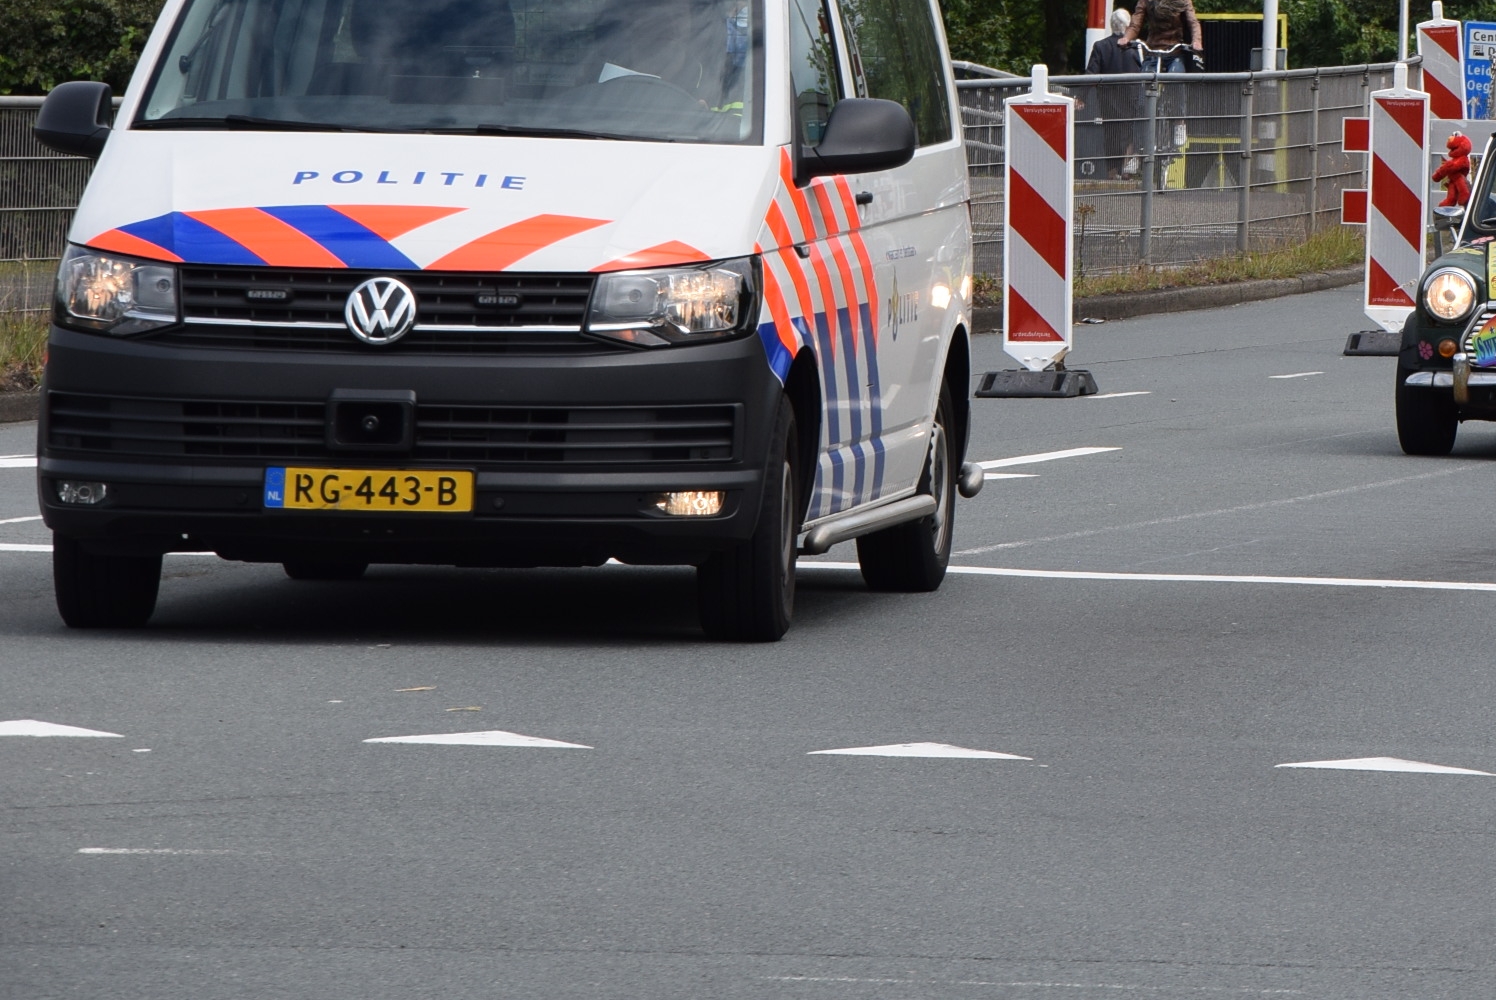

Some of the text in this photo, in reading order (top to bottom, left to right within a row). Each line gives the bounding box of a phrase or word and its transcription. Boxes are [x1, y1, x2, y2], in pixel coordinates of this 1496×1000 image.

[292, 170, 527, 190] POLITIE
[267, 490, 281, 501] NL
[294, 473, 458, 506] RG-443-B
